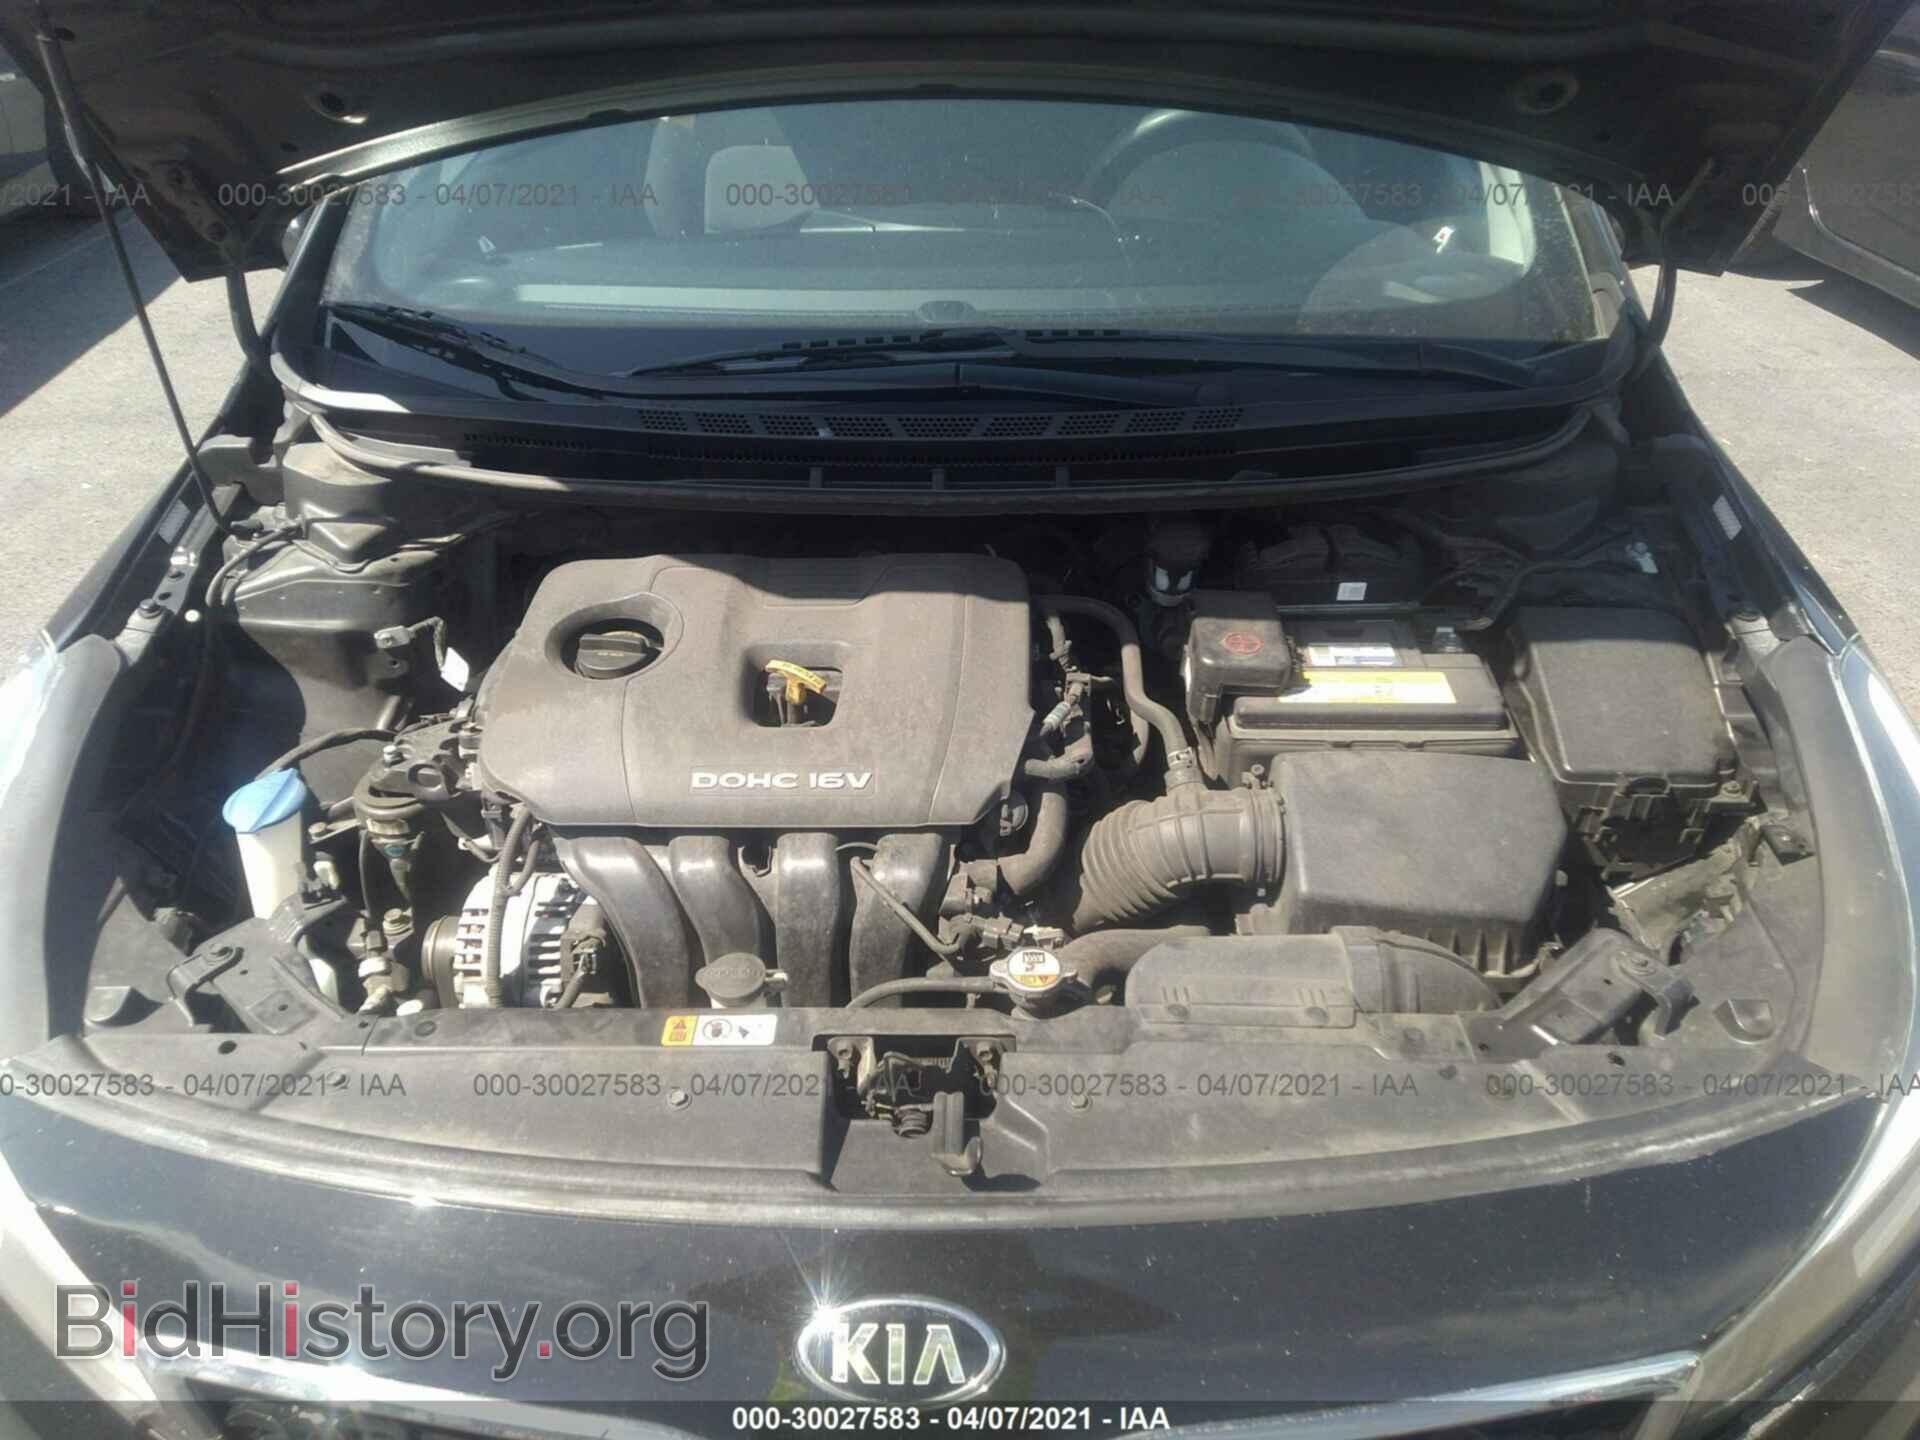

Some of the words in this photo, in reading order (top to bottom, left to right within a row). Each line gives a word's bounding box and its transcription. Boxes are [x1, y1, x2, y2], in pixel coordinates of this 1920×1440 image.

[691, 772, 799, 788] DOHC
[809, 772, 872, 789] 16V
[831, 1323, 966, 1384] KIA
